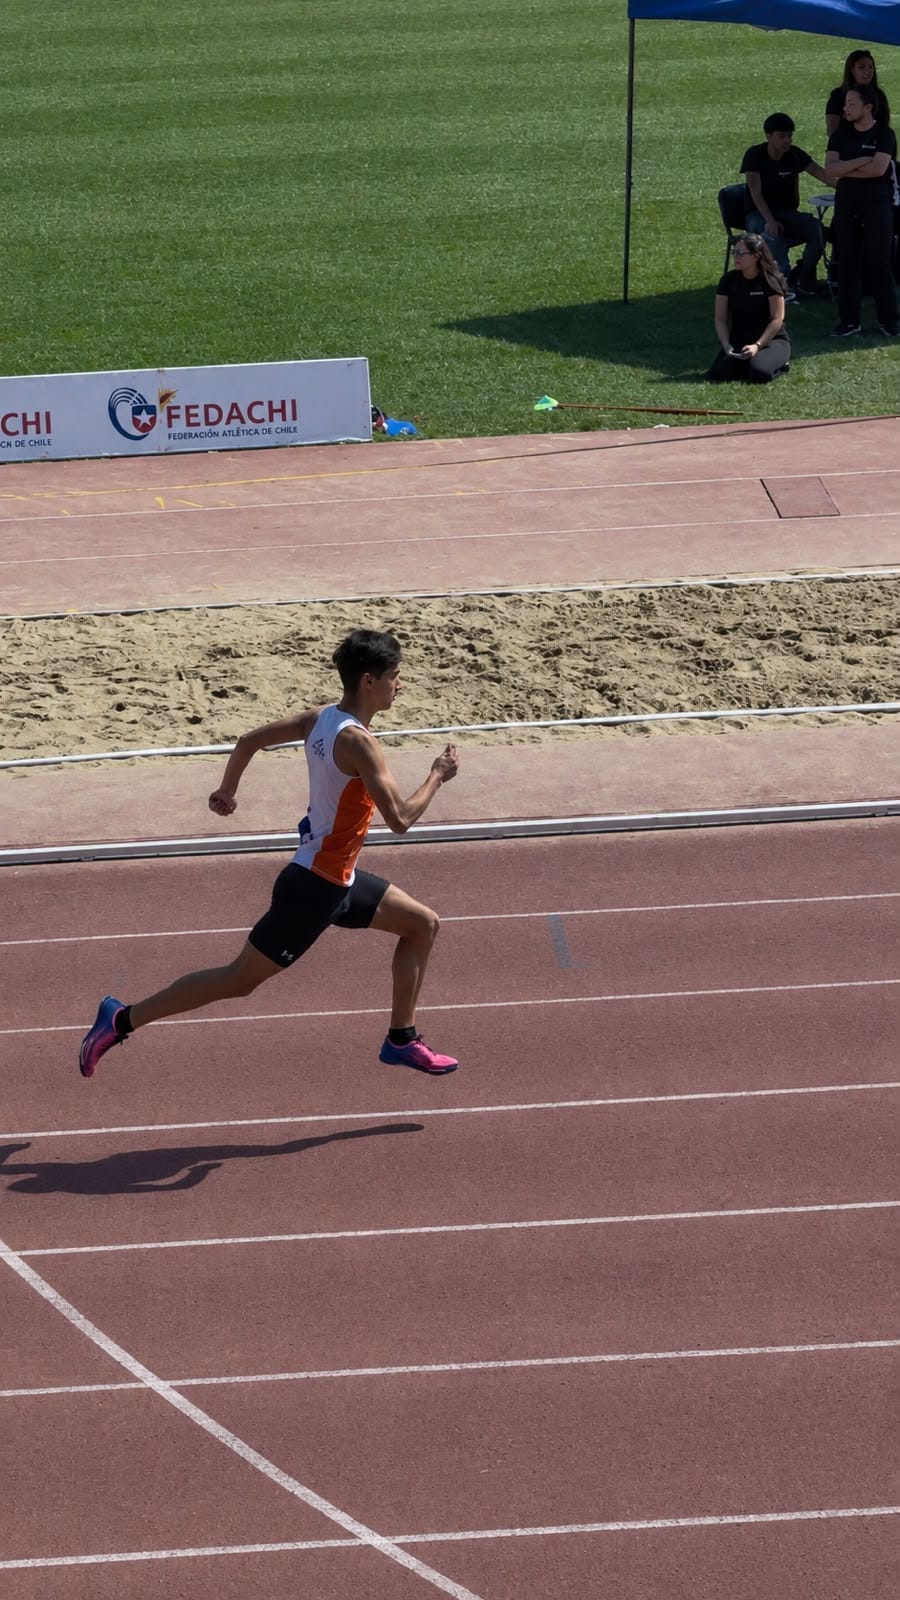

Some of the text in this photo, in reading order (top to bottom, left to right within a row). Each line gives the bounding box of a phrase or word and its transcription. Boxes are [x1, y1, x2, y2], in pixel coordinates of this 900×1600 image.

[166, 399, 298, 428] FEDACHI
[168, 426, 298, 440] FEDERACIÓN ATLÉTICA DE CHILE
[28, 438, 52, 447] CHILE
